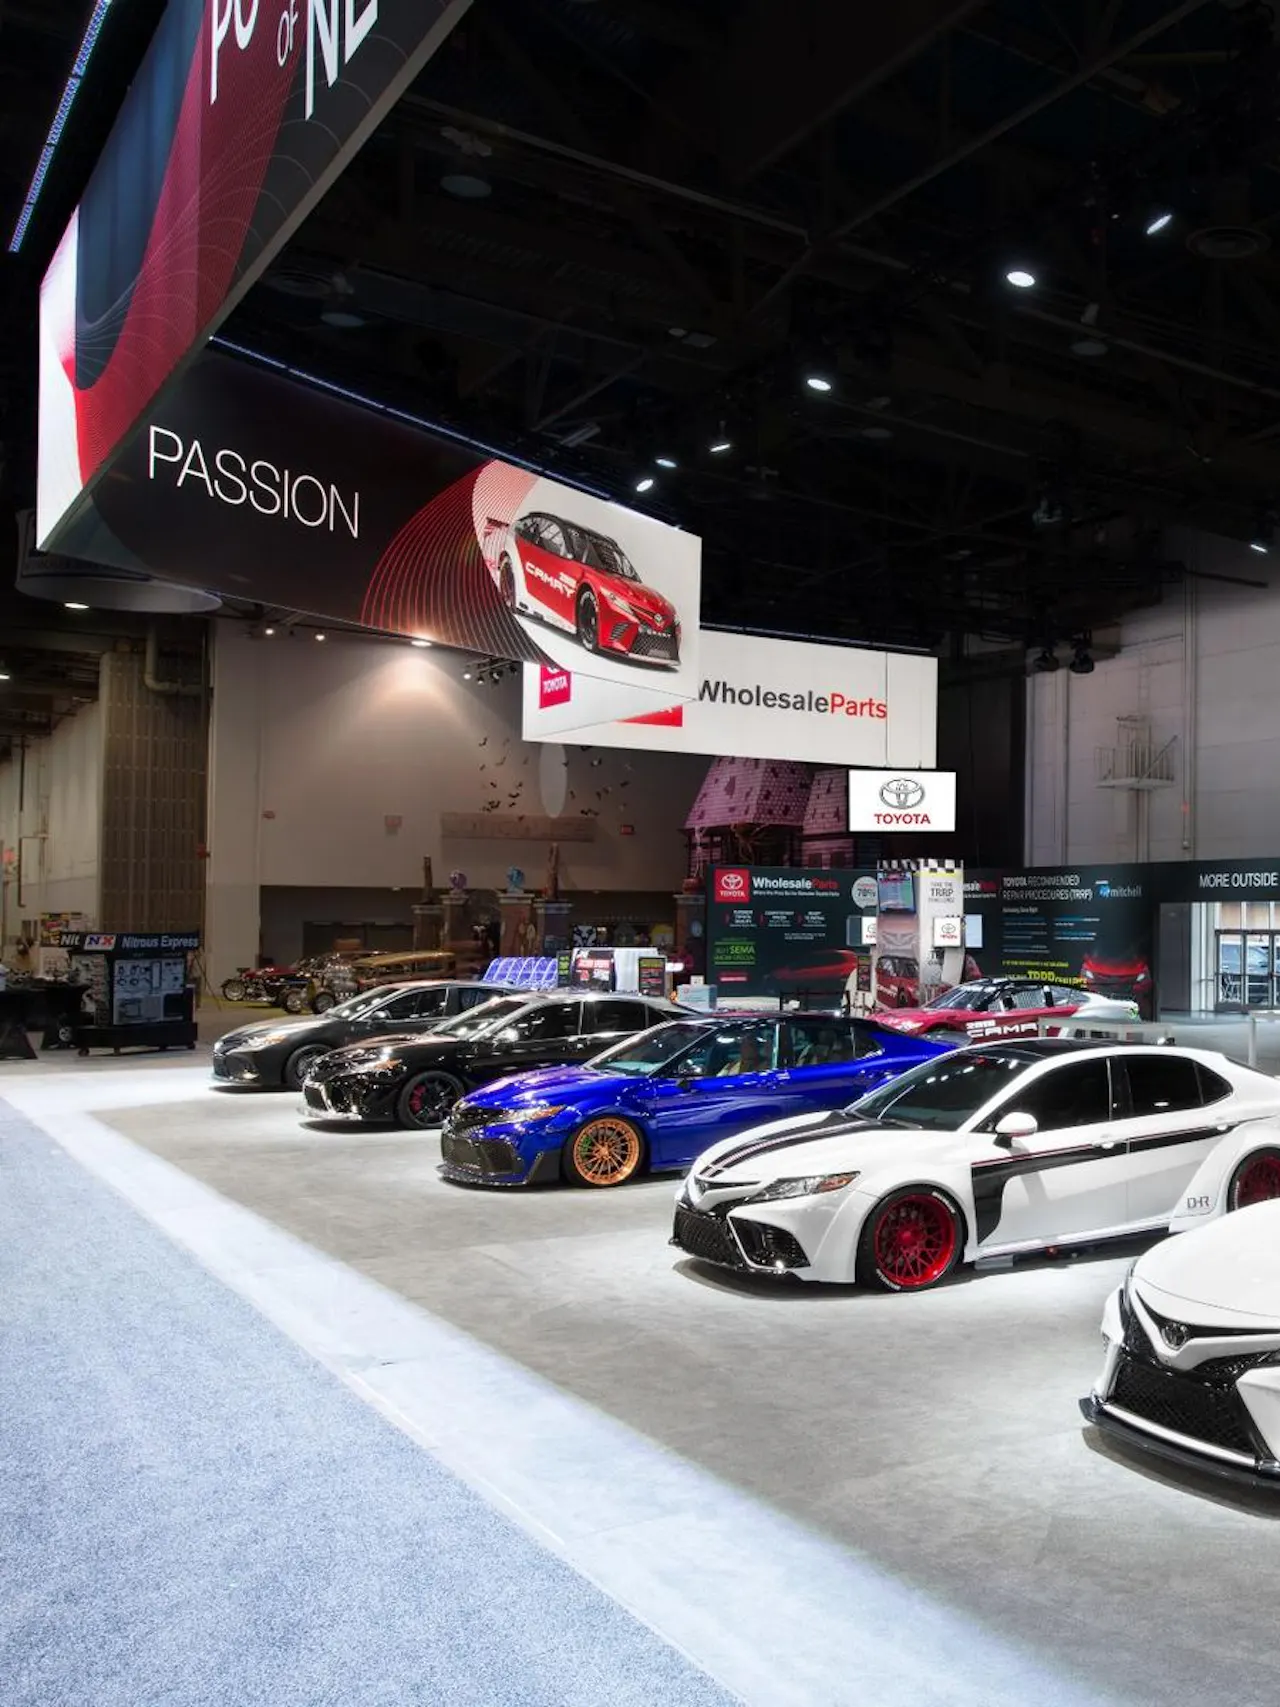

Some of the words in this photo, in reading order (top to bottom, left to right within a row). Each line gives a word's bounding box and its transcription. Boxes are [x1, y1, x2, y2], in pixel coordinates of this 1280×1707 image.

[149, 425, 359, 539] PASSION
[525, 561, 576, 599] CAMRY
[873, 813, 931, 825] TOYOTA
[1199, 873, 1230, 888] MORE
[1231, 871, 1279, 888] OUTSIDE
[122, 936, 158, 948] Nitrous
[161, 935, 199, 948] Express
[966, 1022, 1038, 1038] CAMR
